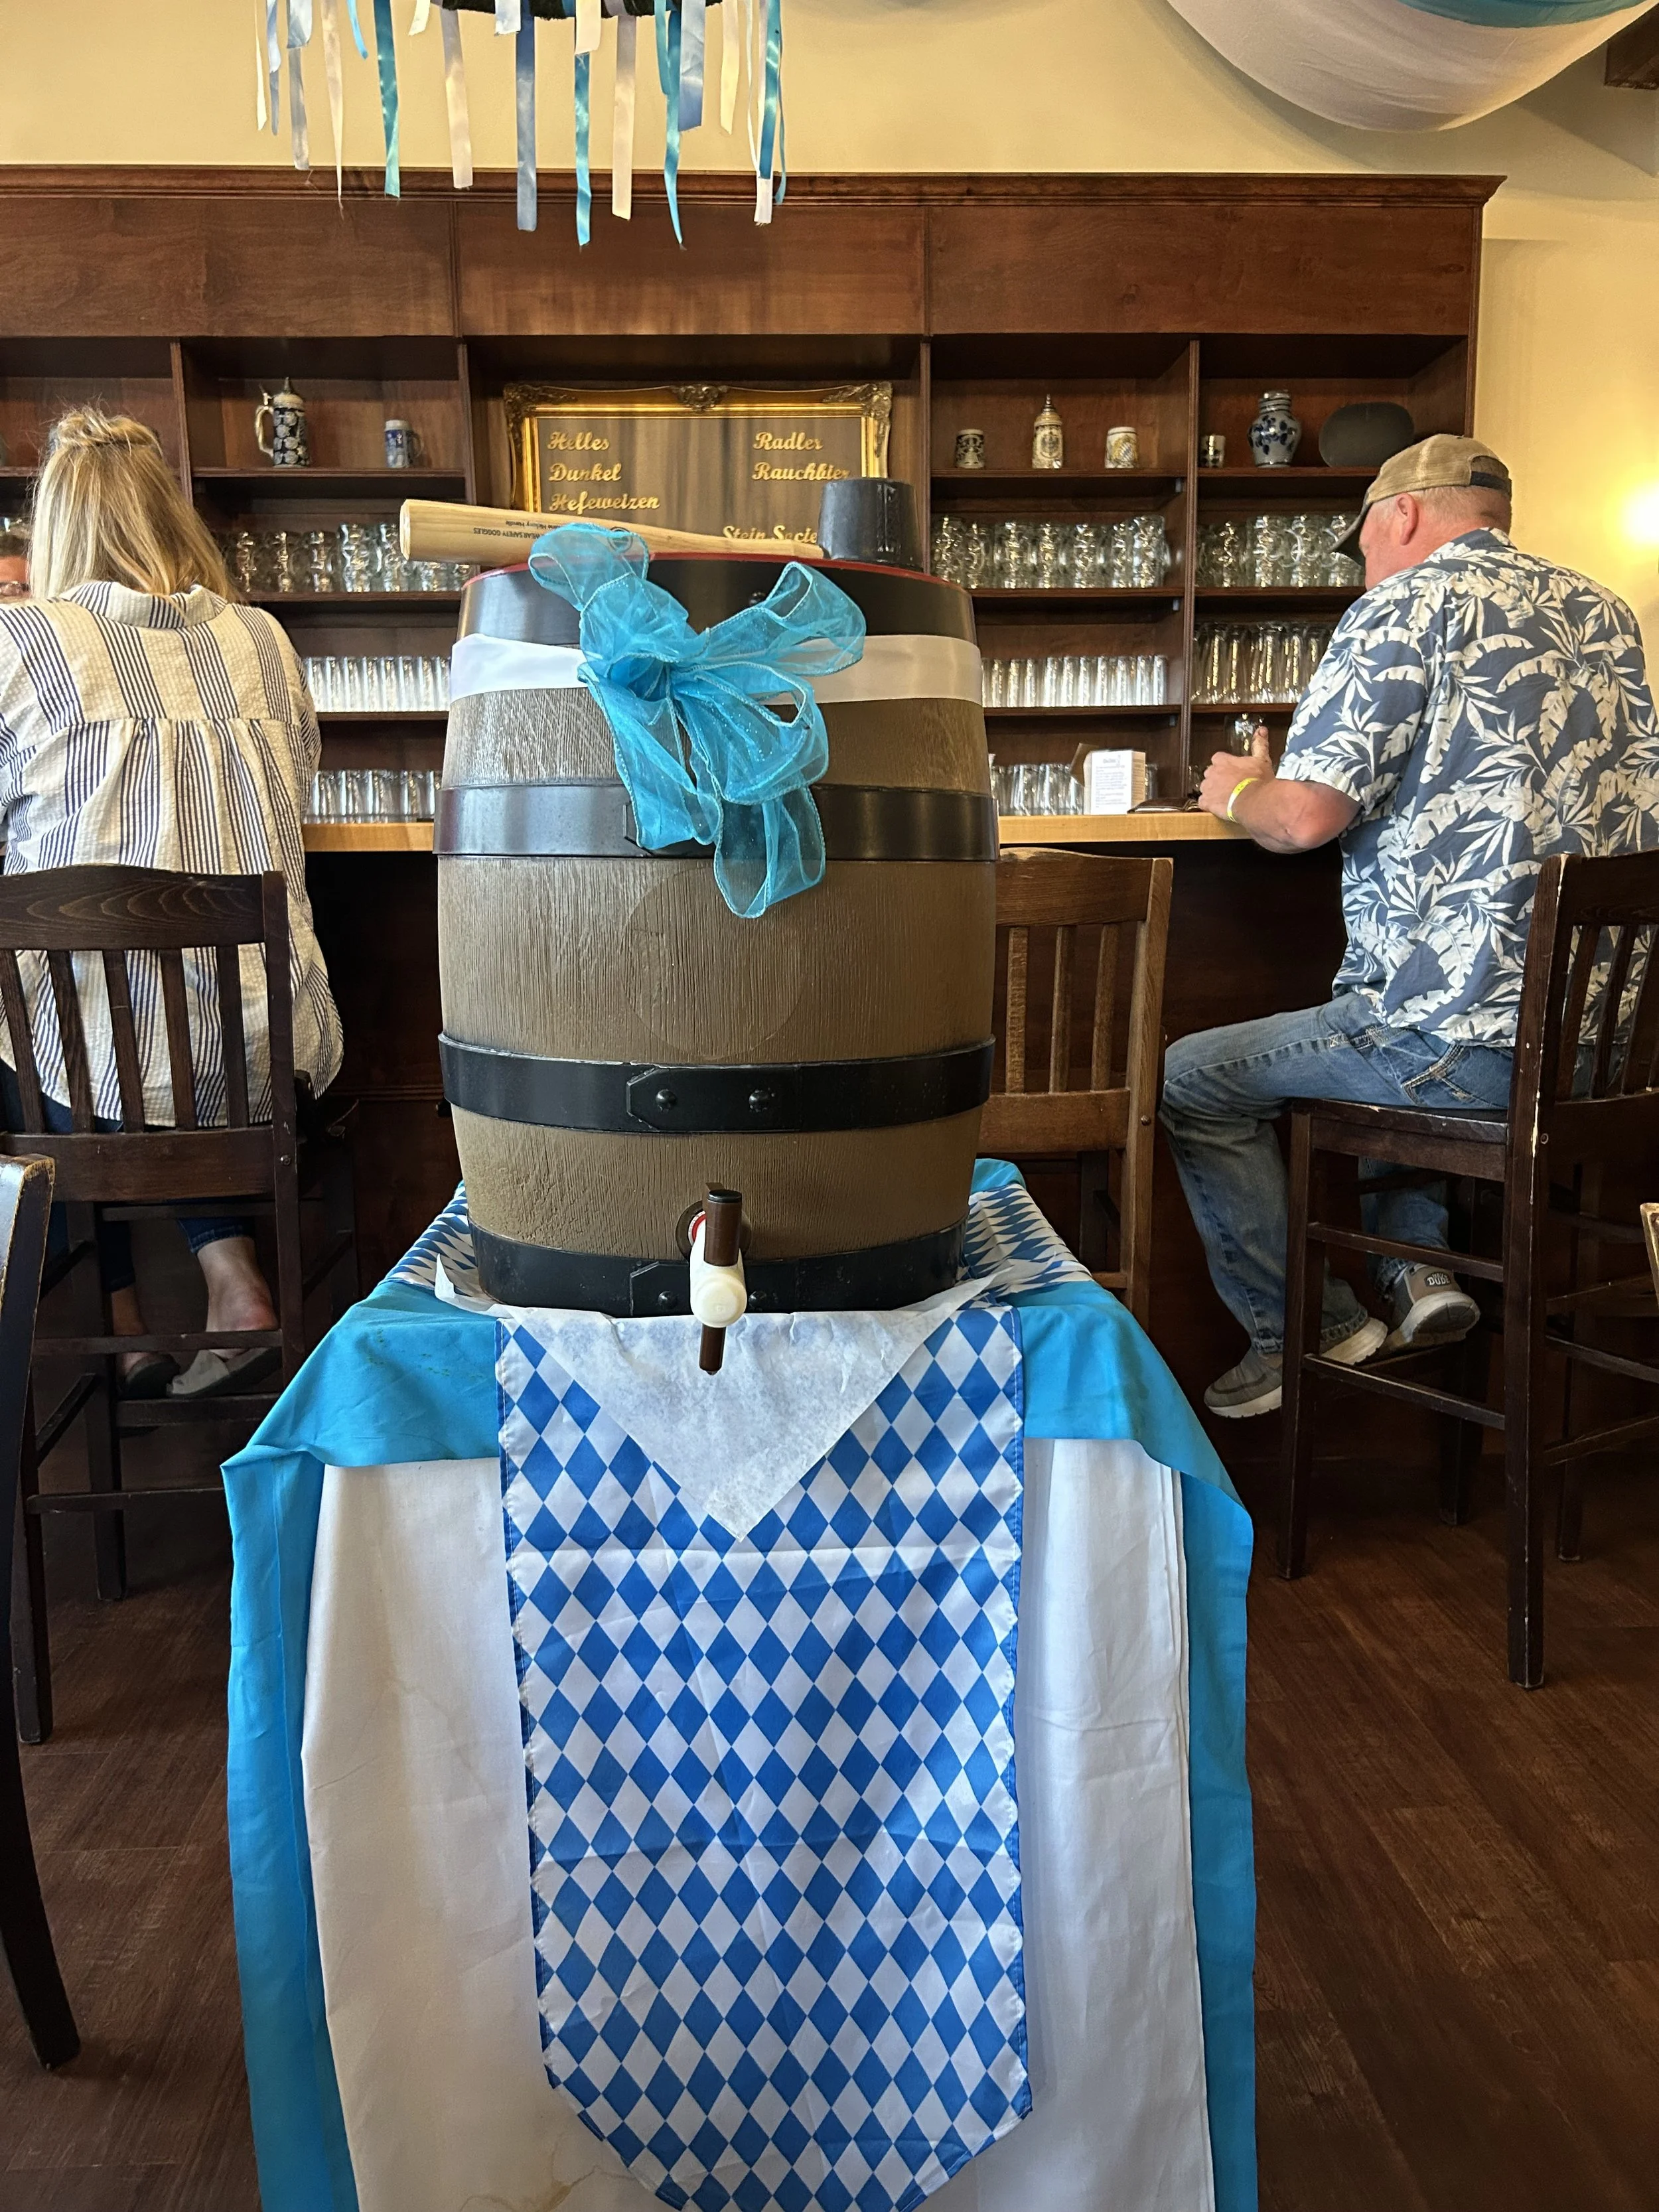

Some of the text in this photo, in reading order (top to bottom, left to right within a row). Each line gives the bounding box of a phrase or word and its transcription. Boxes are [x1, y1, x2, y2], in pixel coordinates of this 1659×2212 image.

[547, 431, 610, 451] Helles
[753, 431, 824, 451] Radler
[549, 463, 622, 481] Dunkel
[751, 462, 850, 480] Rauchbier
[549, 490, 661, 515] Hefeweizen
[473, 527, 501, 536] GOGGLES
[772, 525, 818, 544] Socie
